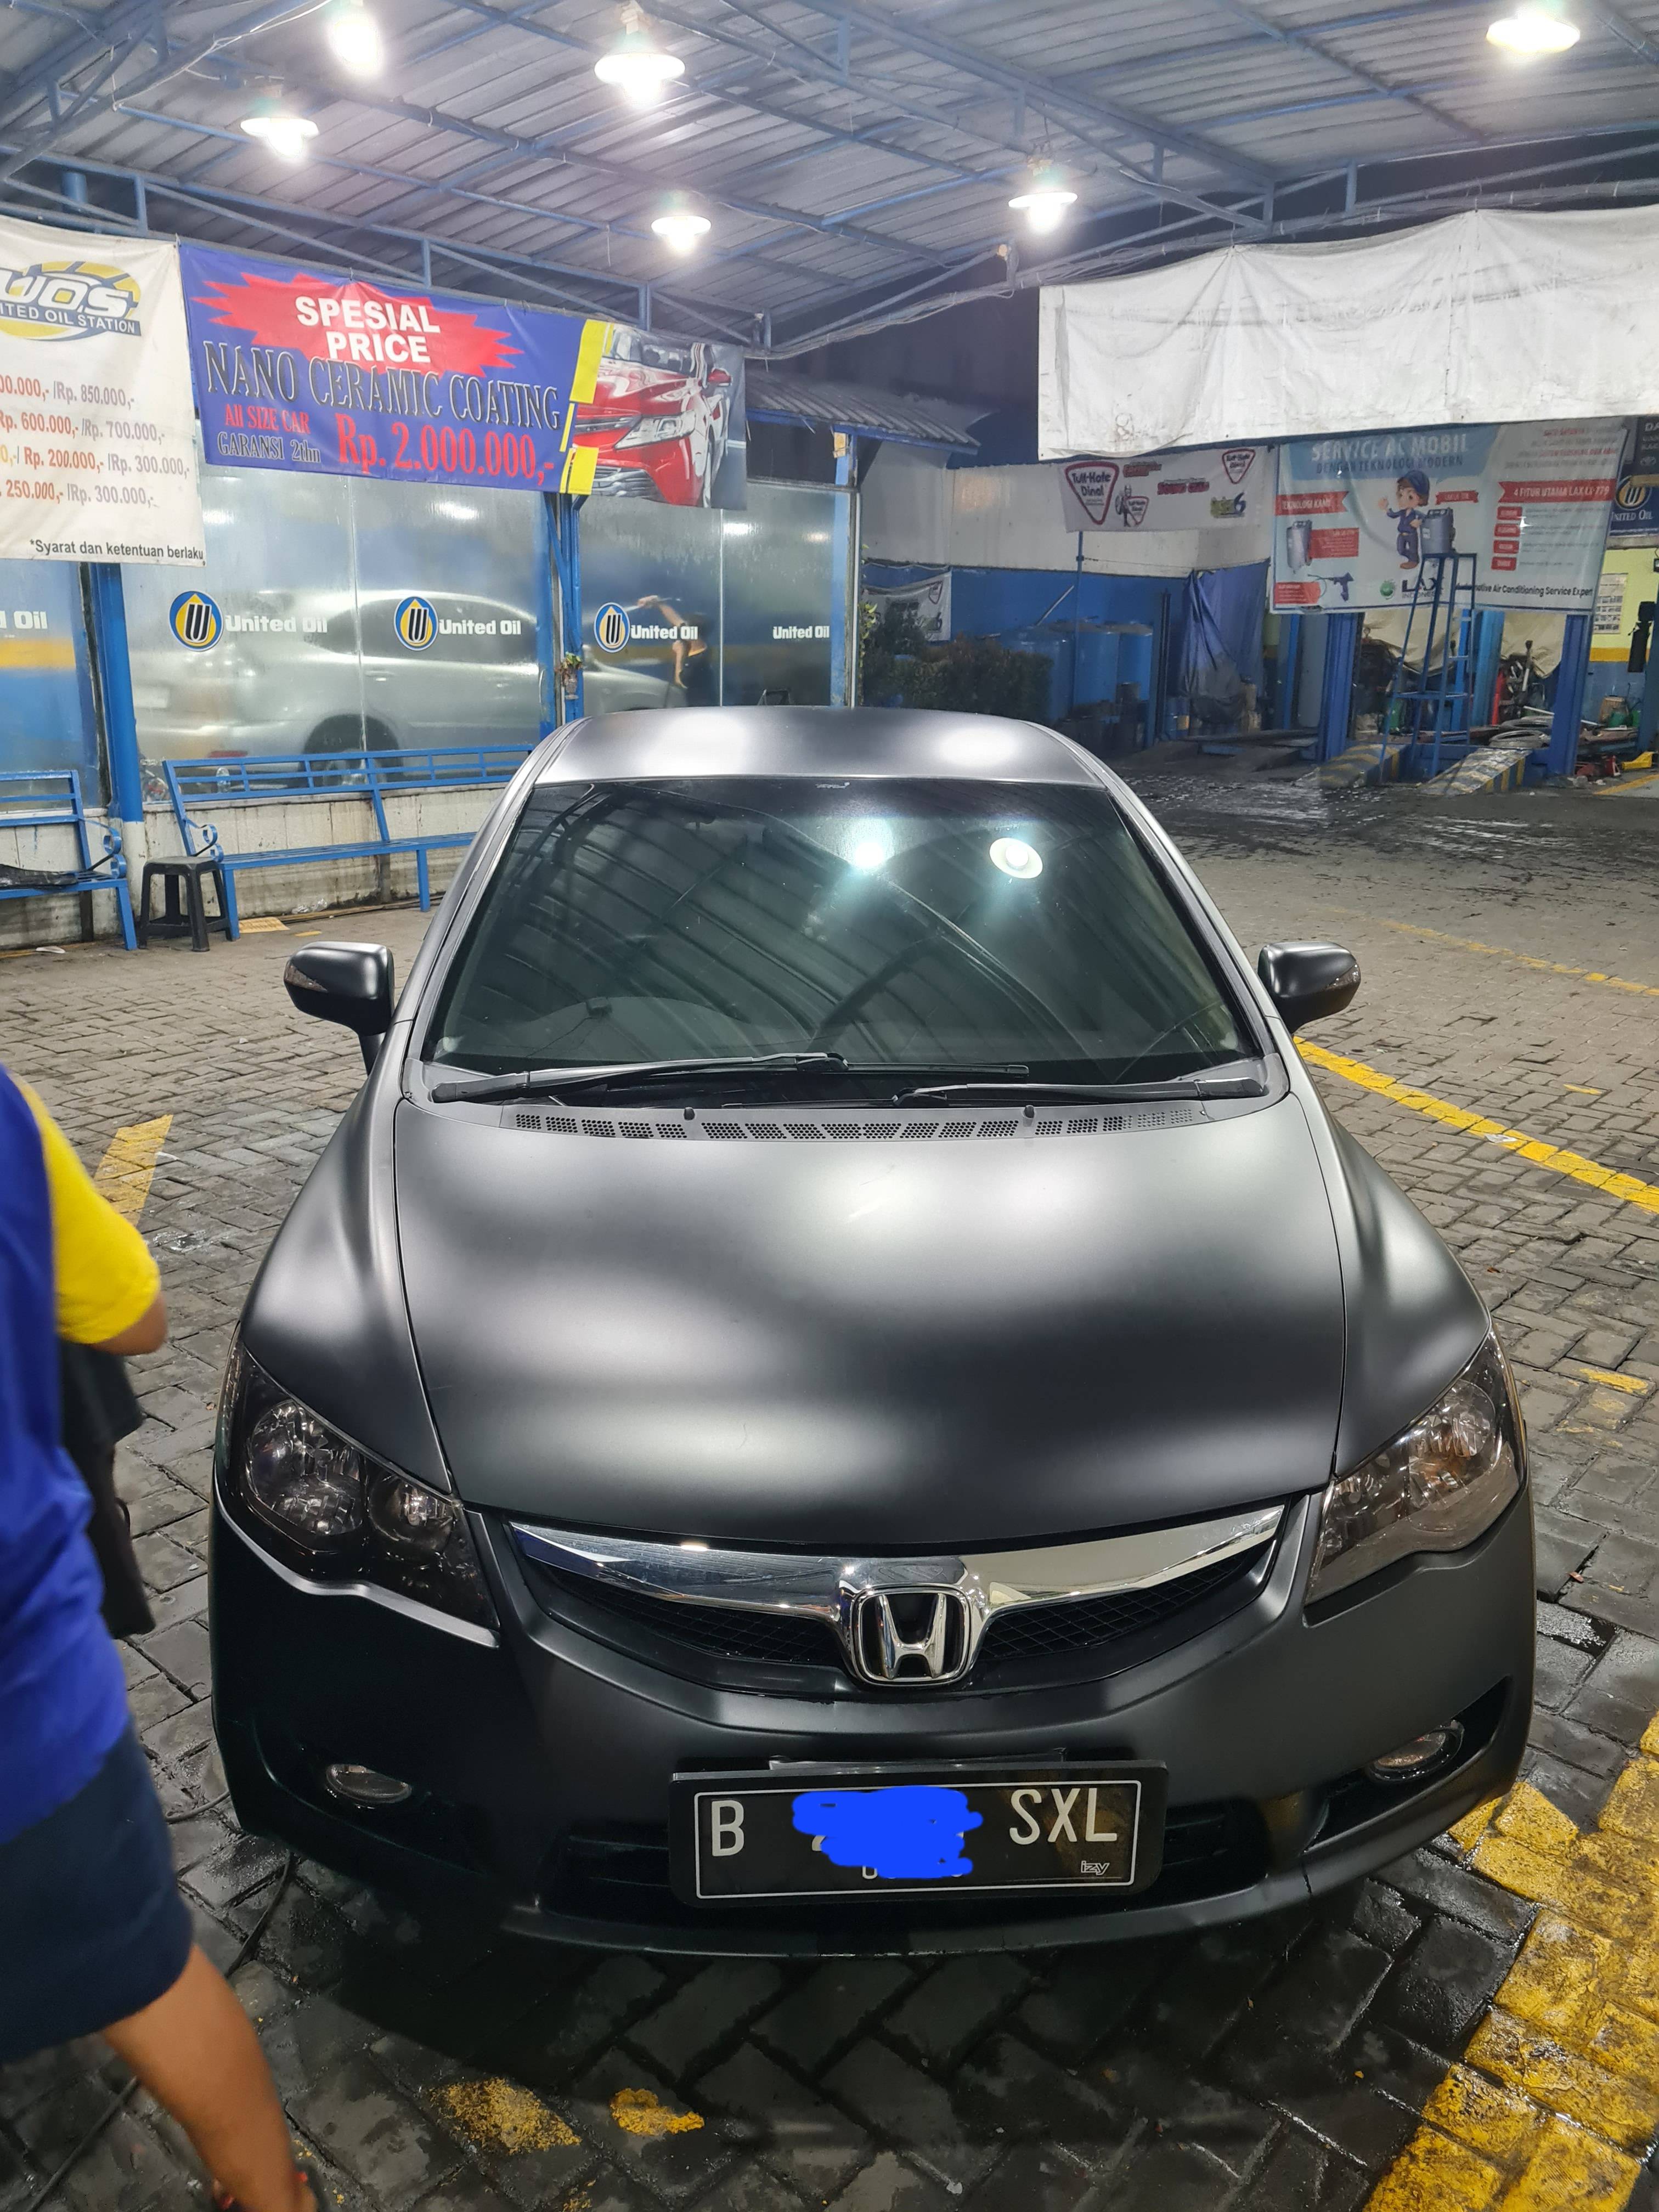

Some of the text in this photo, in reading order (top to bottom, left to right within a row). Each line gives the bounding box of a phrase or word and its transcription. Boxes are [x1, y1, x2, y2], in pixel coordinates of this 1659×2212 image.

[45, 309, 74, 325] OIL
[77, 314, 135, 334] STATION
[295, 295, 441, 334] SPESIAL
[326, 331, 431, 364] PRICE
[202, 340, 561, 431] NANO CERAMIC COATING
[246, 405, 280, 432] SIZE
[281, 410, 311, 435] CAR
[24, 446, 44, 470] Rp.
[217, 431, 321, 463] GARANSI 2thn
[80, 541, 103, 555] dan
[106, 542, 164, 557] ketentuan
[167, 545, 204, 560] berlaku
[14, 610, 48, 629] Oil
[225, 614, 328, 633] United Oil
[439, 619, 521, 635] United Oil
[631, 624, 698, 640] United Oil
[772, 625, 830, 639] United Oil
[711, 1799, 745, 1857] B
[1009, 1787, 1118, 1846] SXL
